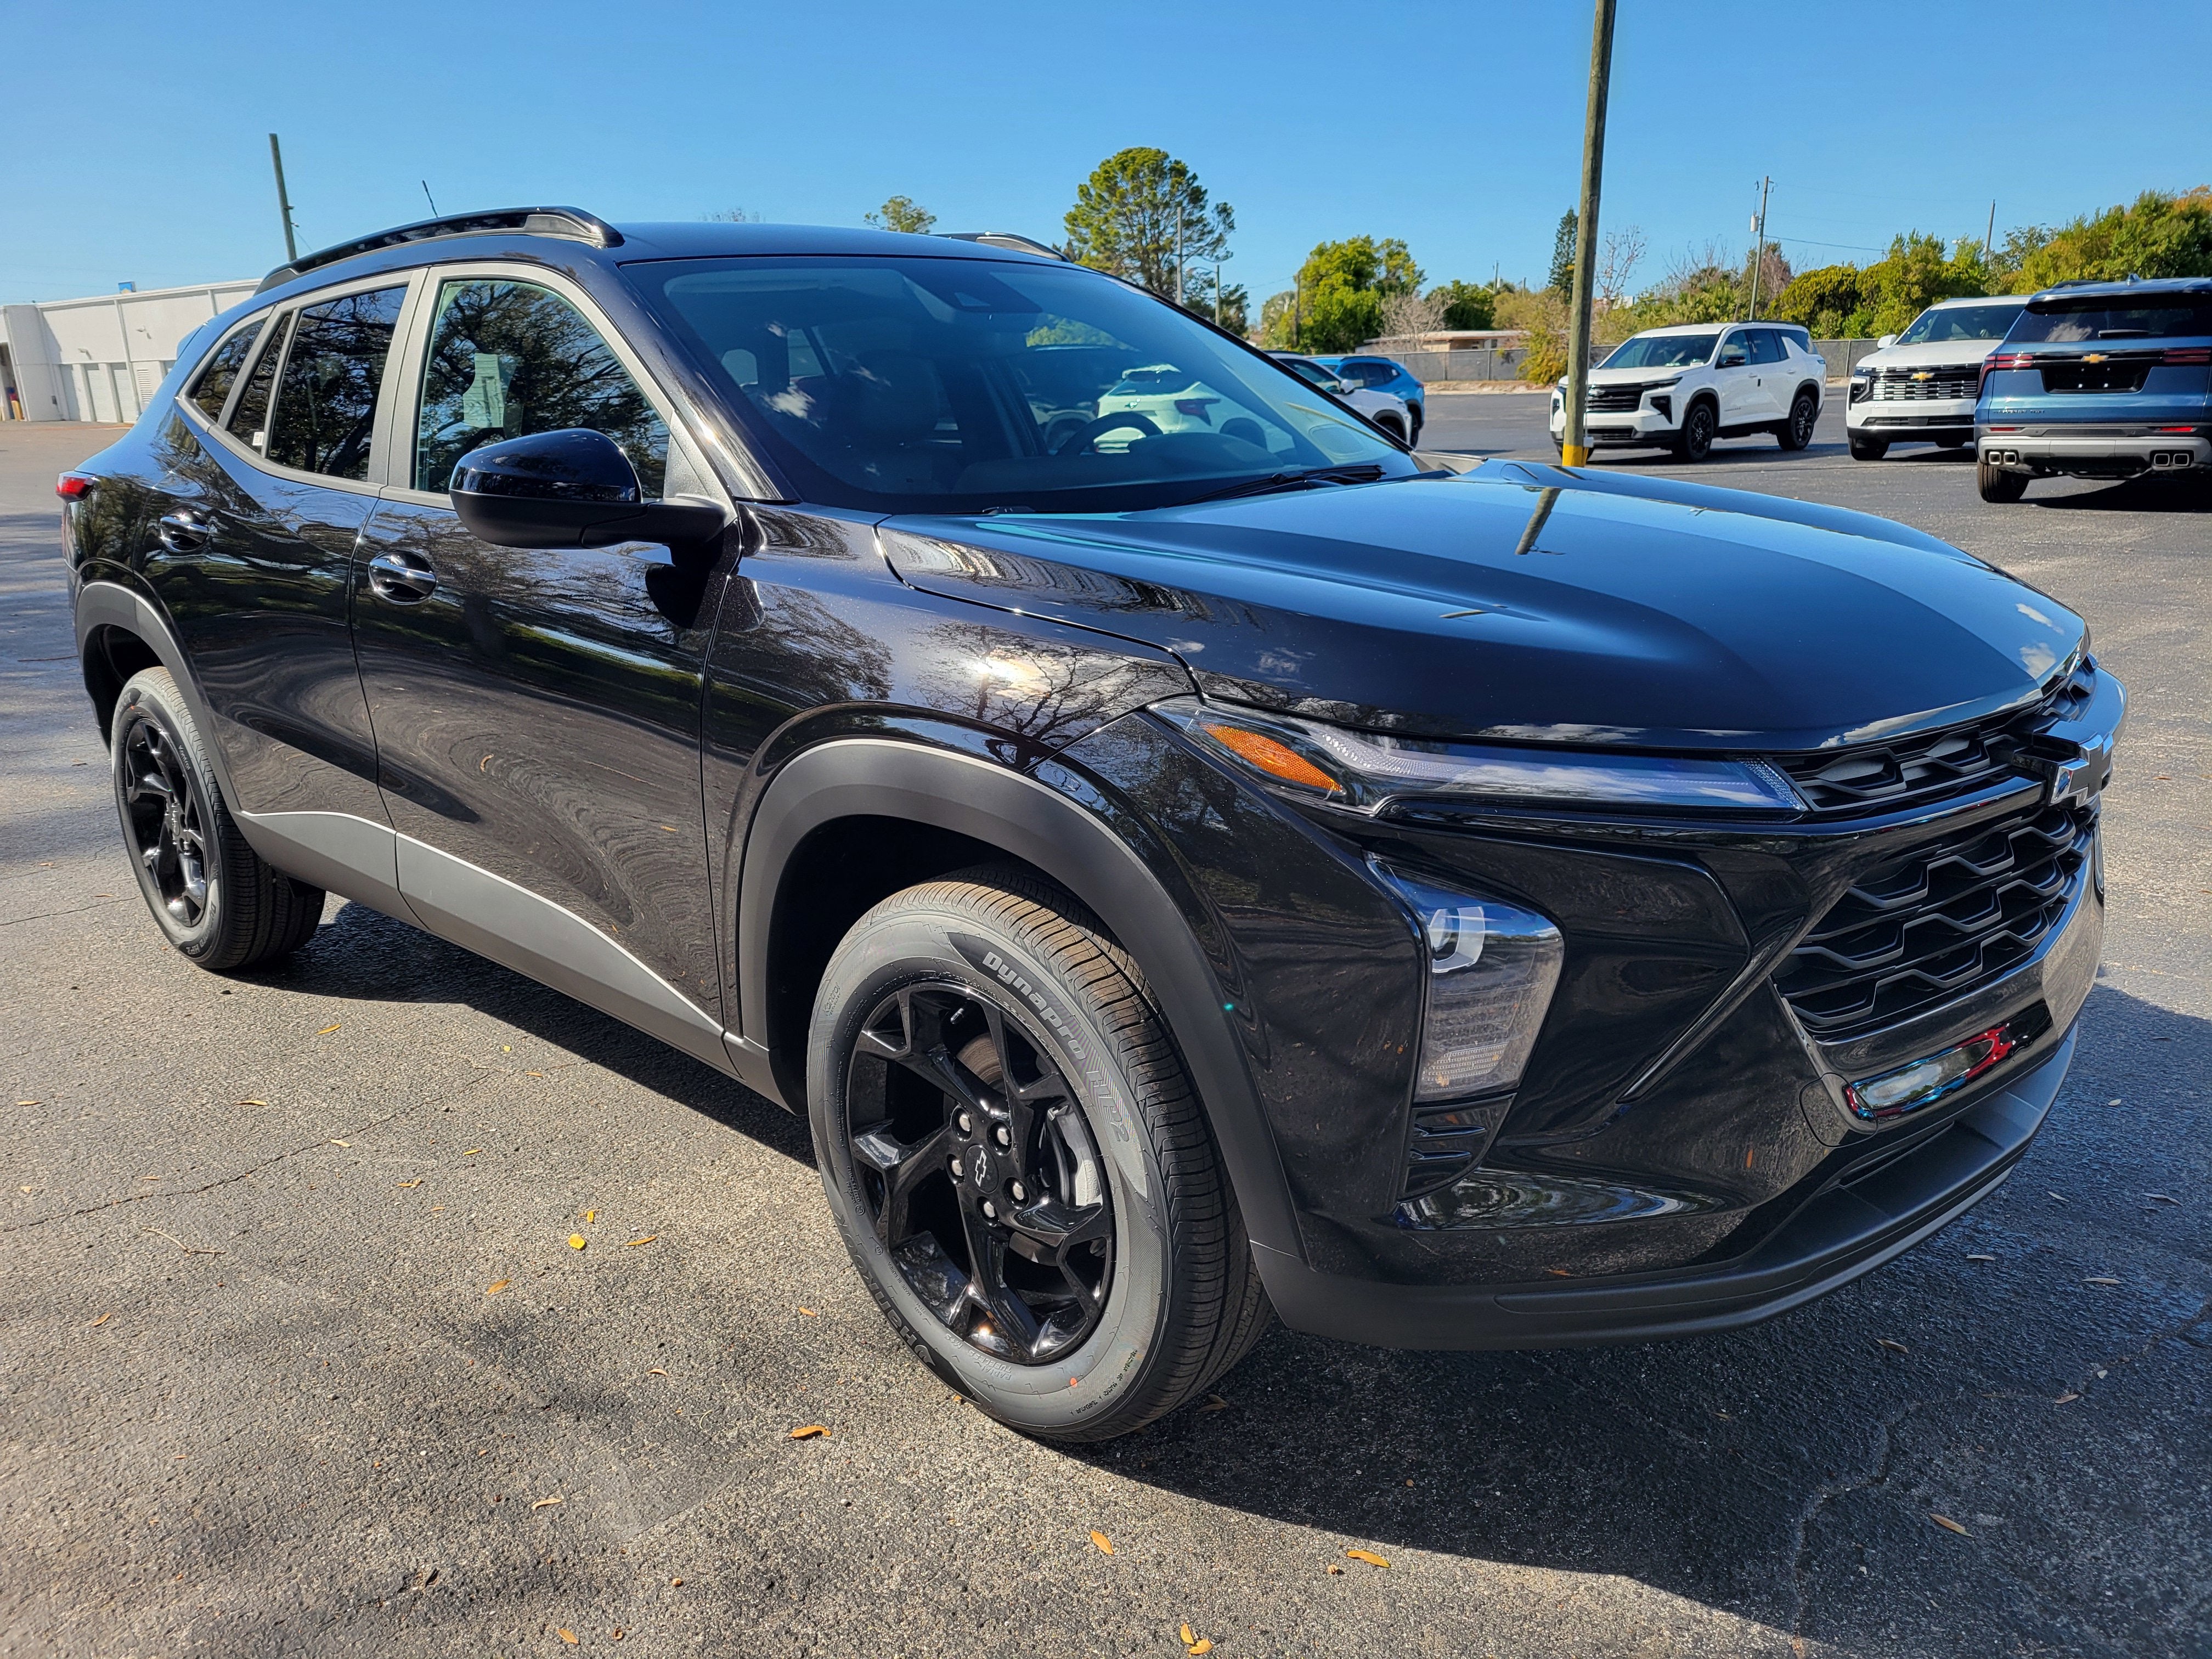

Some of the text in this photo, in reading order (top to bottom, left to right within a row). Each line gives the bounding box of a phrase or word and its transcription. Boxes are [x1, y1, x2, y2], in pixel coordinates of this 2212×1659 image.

[982, 951, 1086, 1060] Dynapro
[1086, 1070, 1129, 1142] HP2
[969, 1350, 1012, 1373] TUBELESS
